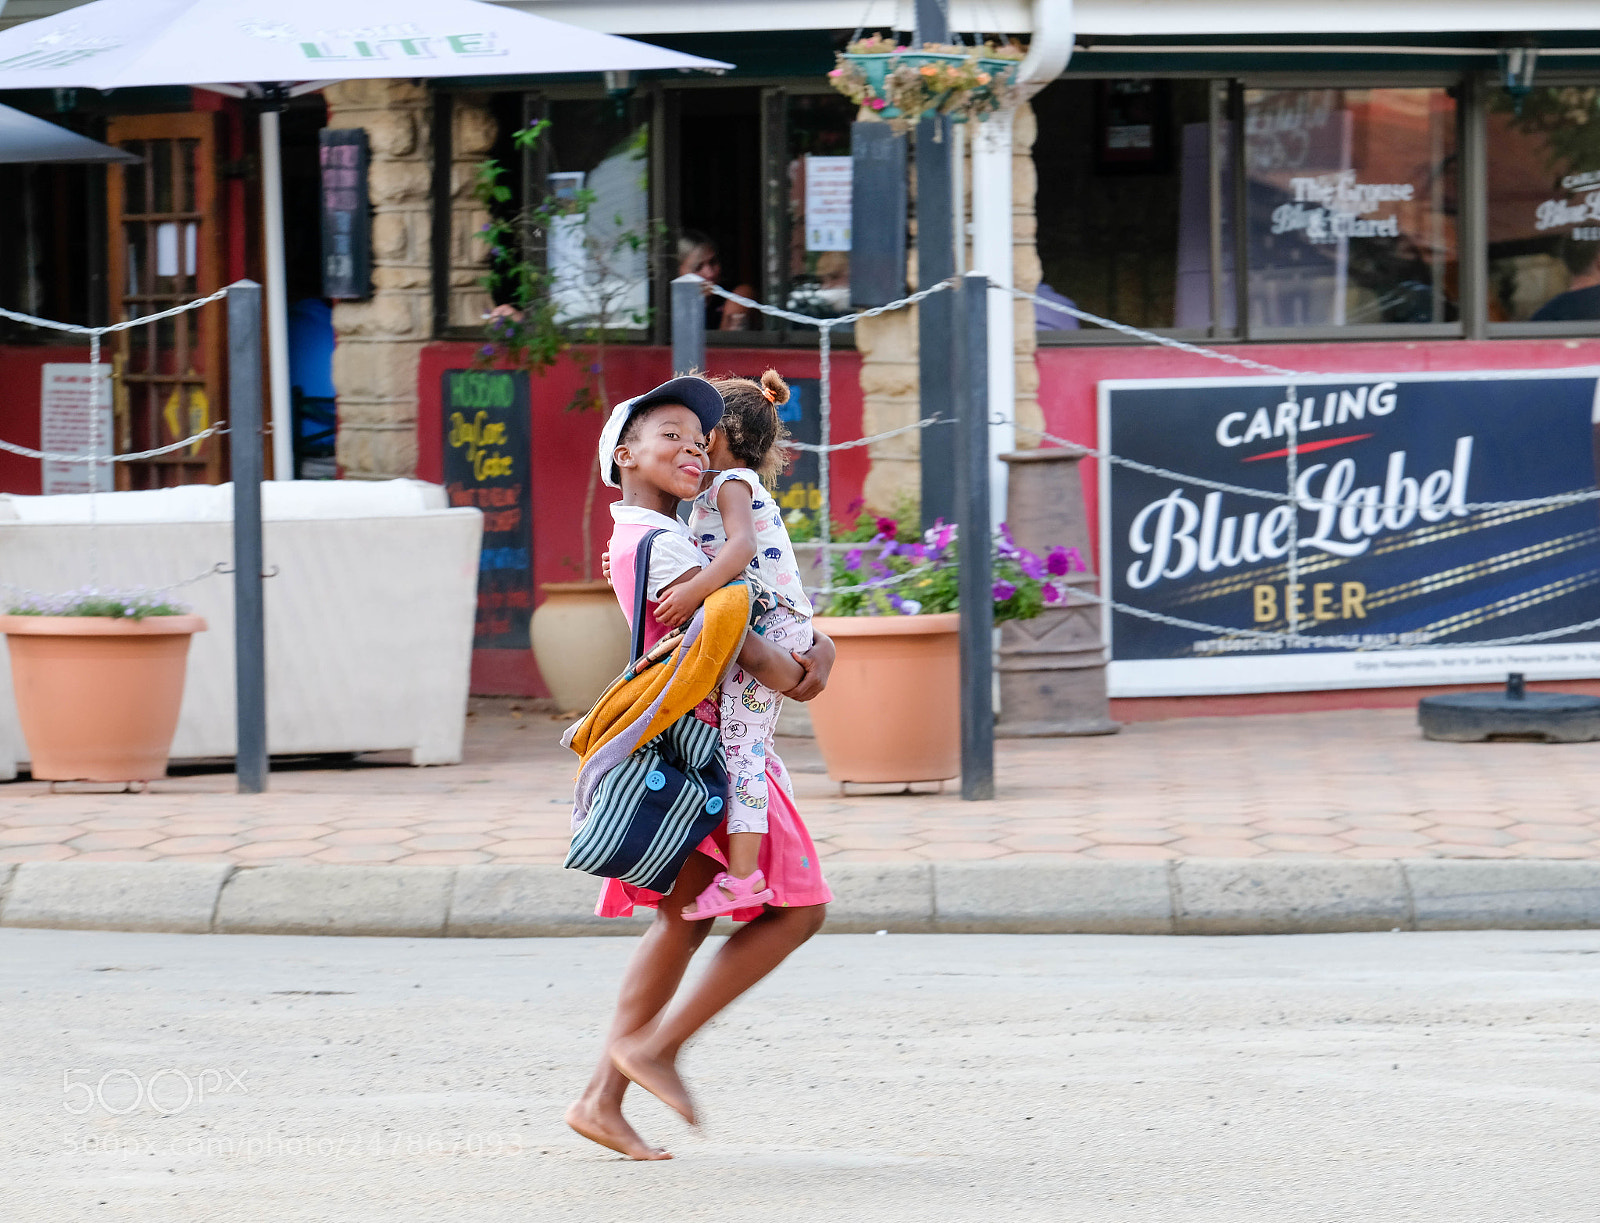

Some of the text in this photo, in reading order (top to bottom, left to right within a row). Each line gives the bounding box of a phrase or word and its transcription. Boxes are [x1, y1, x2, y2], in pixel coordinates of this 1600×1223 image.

[300, 32, 508, 62] LITE
[1535, 198, 1586, 231] Blue
[1216, 381, 1398, 448] CARLING
[1126, 435, 1475, 589] Blue Label
[1253, 581, 1367, 623] BEER
